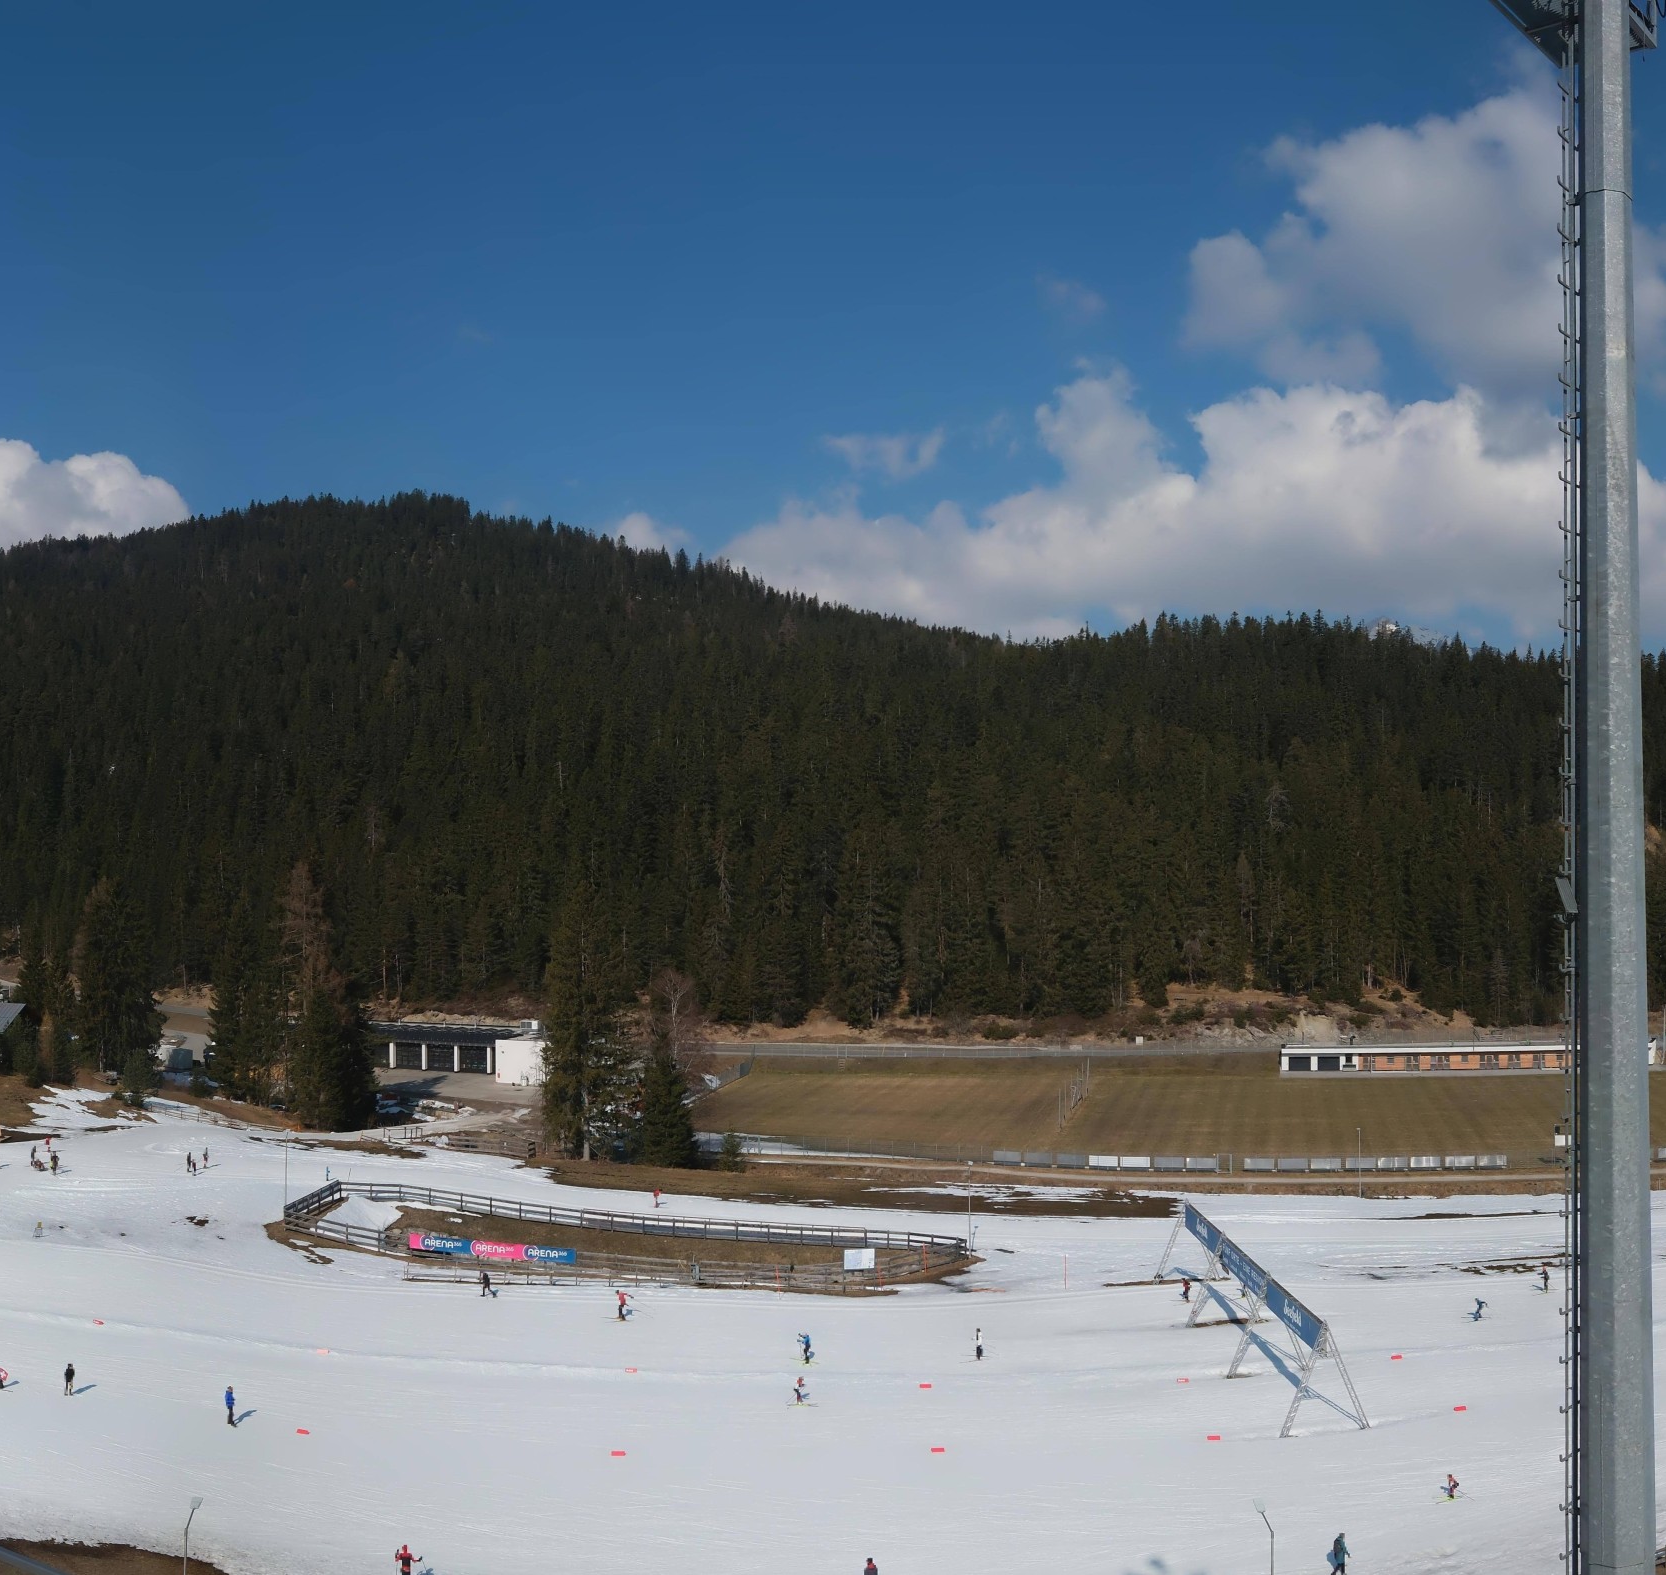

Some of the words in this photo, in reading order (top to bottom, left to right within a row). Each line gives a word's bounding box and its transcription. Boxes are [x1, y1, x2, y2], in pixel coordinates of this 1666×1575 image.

[424, 1238, 454, 1248] ARENA
[475, 1243, 506, 1253] ARENA
[527, 1249, 559, 1258] ARENA
